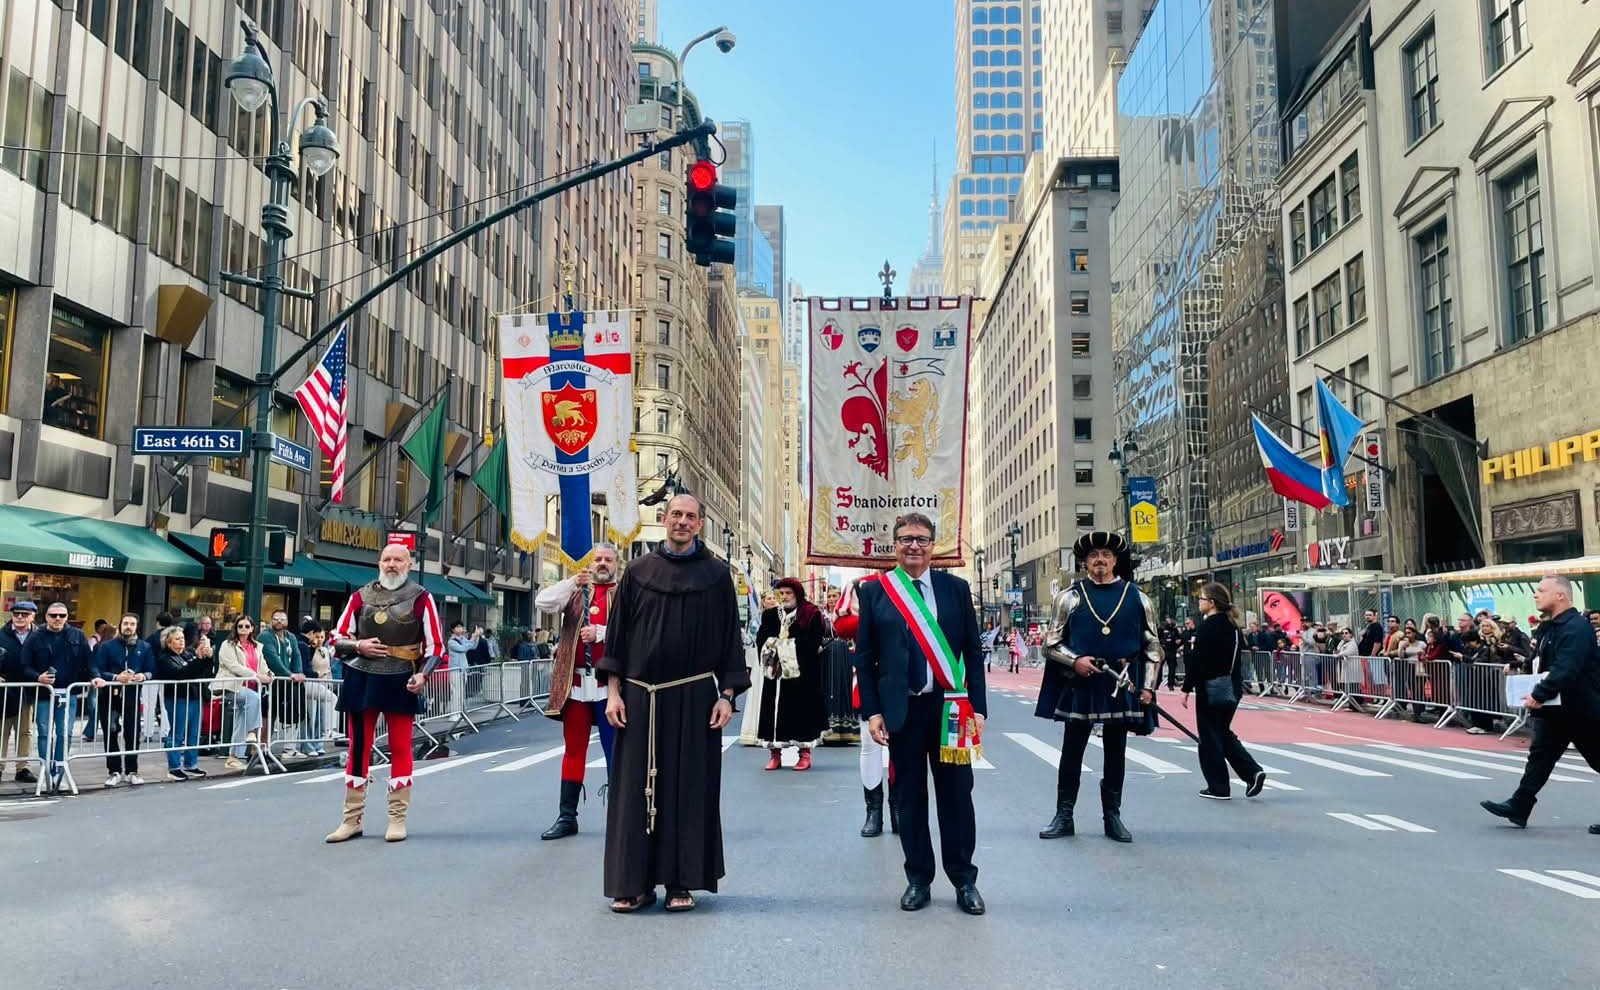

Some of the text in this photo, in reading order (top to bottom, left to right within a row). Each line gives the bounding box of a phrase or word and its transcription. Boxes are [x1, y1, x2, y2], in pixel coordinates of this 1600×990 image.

[543, 362, 592, 375] Marostica
[142, 434, 236, 448] East 46th St
[278, 442, 306, 465] Fifth Ave
[541, 458, 567, 473] Partita
[575, 456, 606, 472] Scacchi
[1481, 428, 1600, 486] PHILIPP
[835, 486, 938, 509] Sbandieratori
[1369, 482, 1381, 508] GIFTS
[835, 516, 876, 535] Borghi
[882, 524, 888, 532] e
[1133, 510, 1154, 525] Be
[1287, 507, 1297, 529] GIFTS
[1318, 535, 1350, 567] NY
